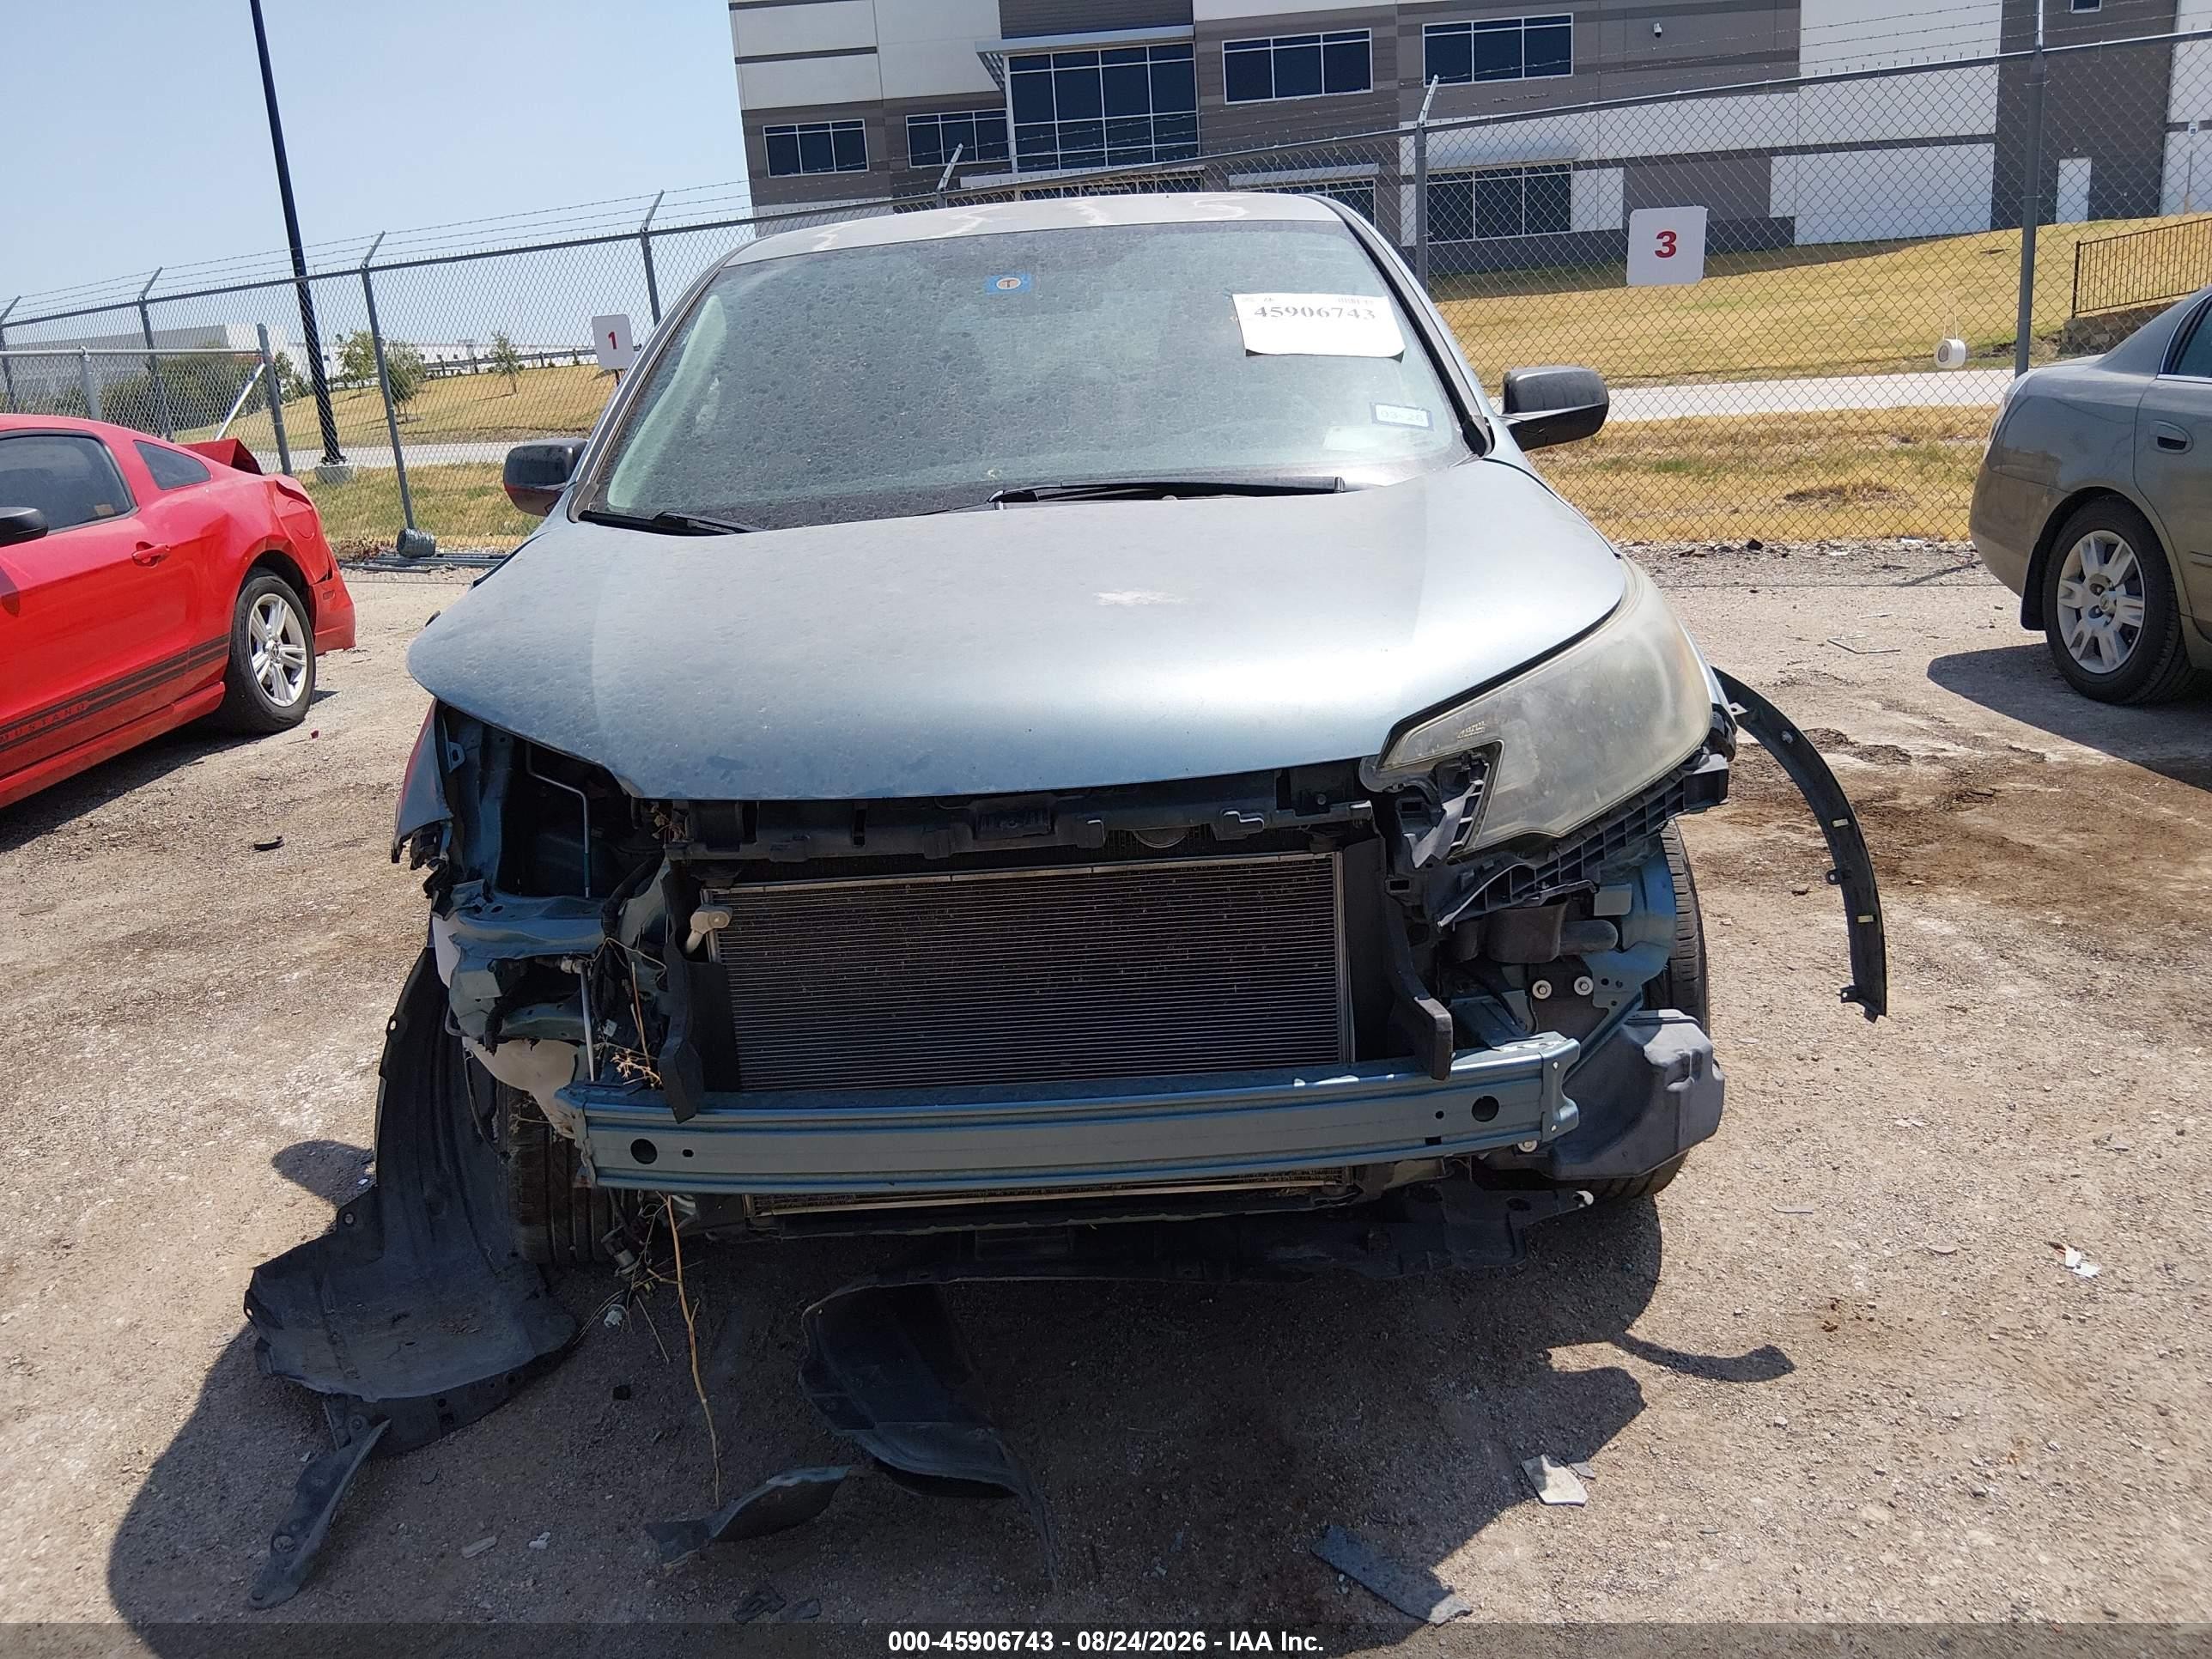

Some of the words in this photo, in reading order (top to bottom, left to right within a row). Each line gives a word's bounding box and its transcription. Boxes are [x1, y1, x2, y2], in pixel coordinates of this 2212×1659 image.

[1655, 231, 1677, 258] 3
[1254, 306, 1376, 320] 45906743
[608, 331, 617, 350] 1
